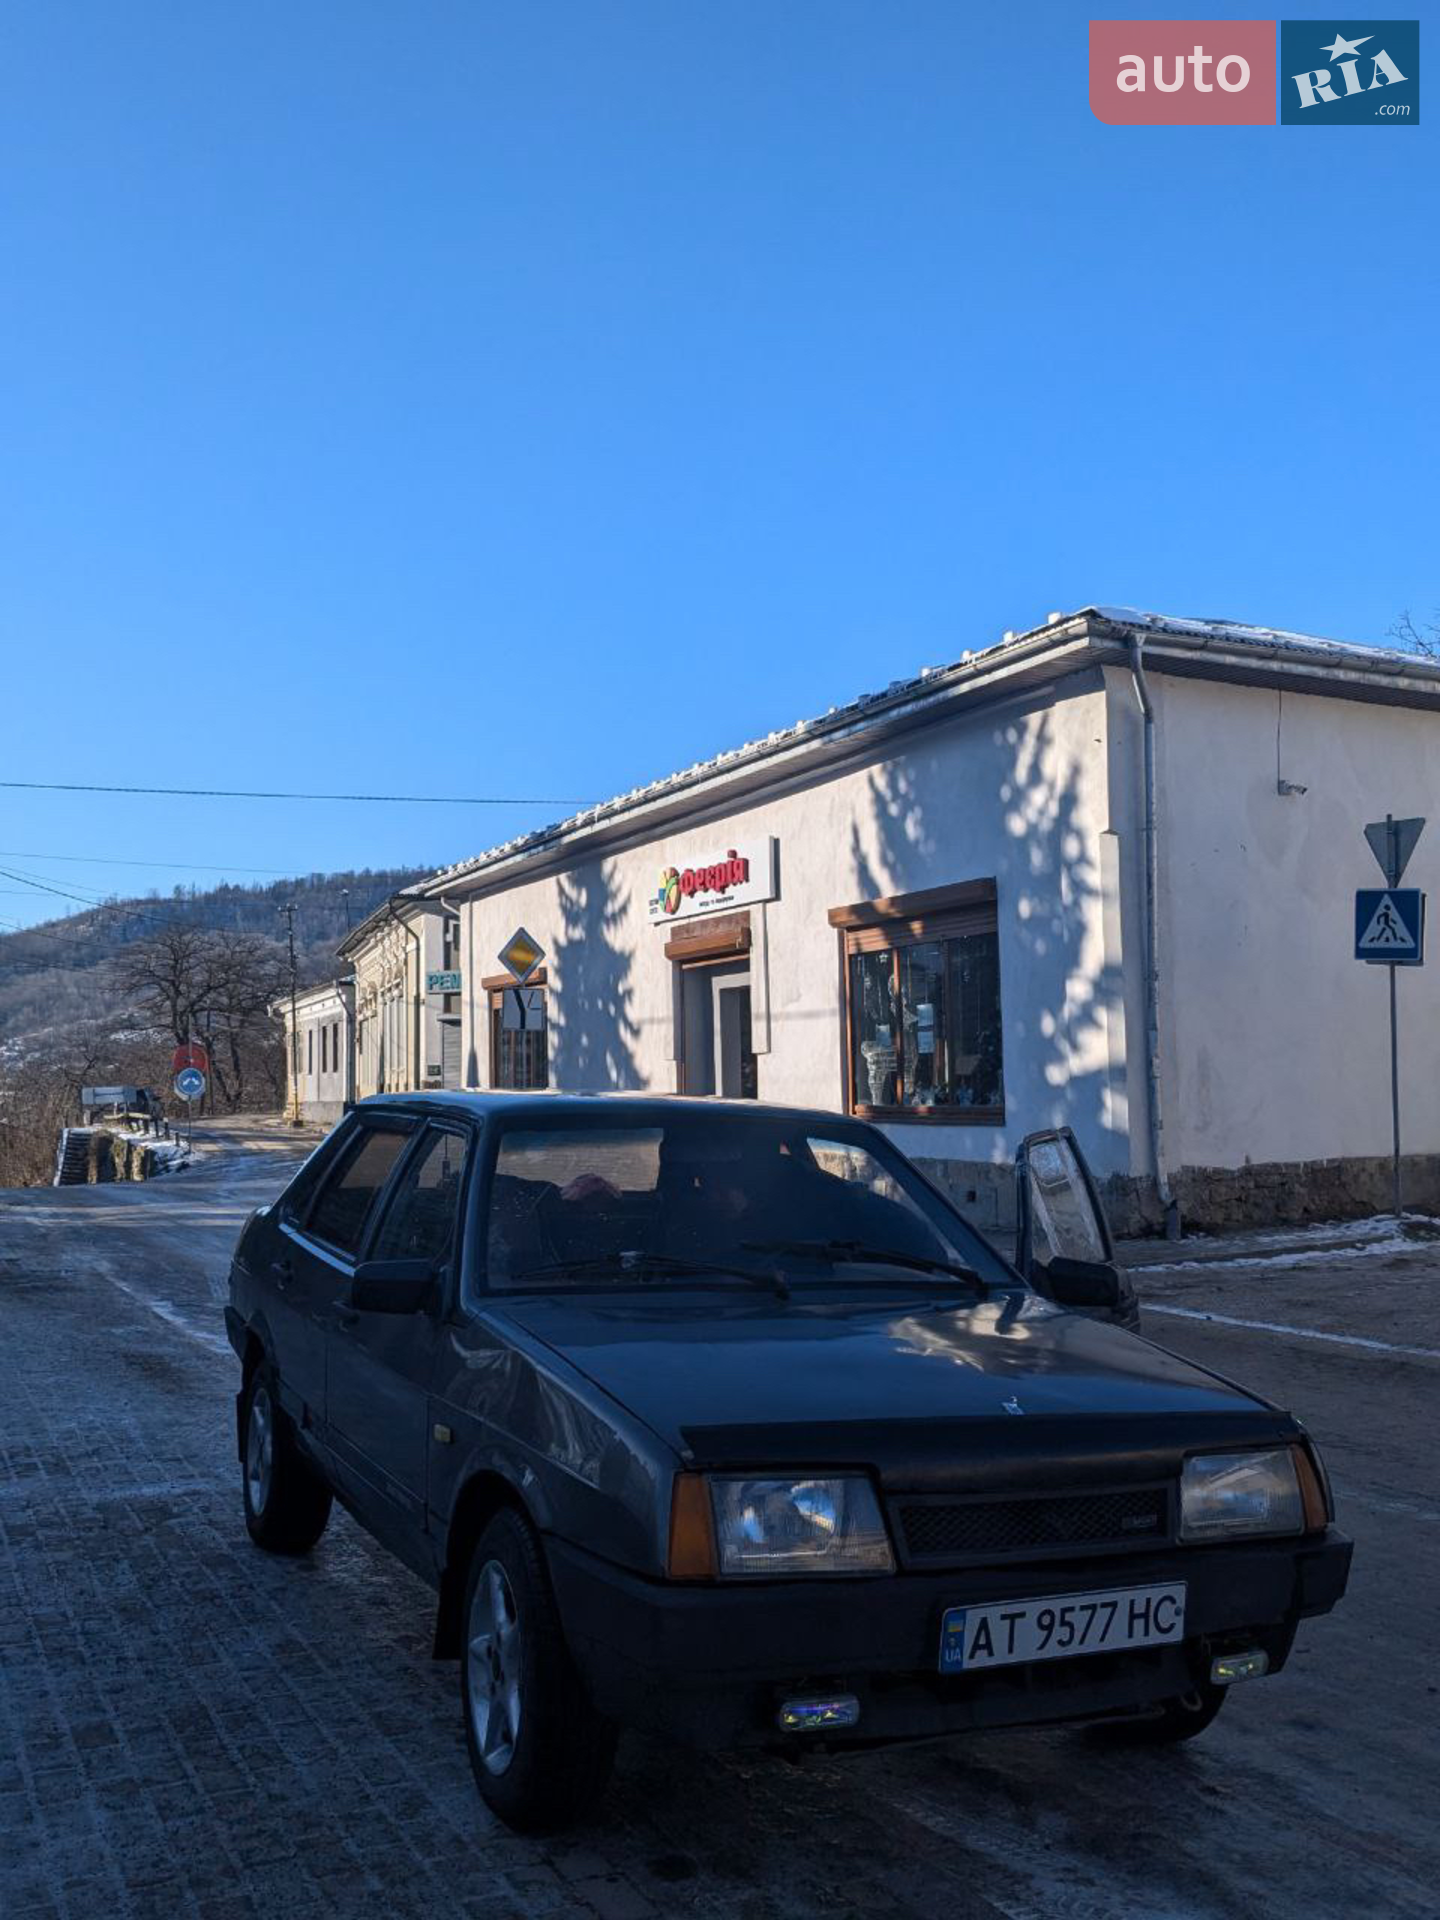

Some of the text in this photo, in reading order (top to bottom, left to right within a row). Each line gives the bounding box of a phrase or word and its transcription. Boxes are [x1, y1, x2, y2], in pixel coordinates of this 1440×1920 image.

[968, 1595, 1177, 1660] AT 9577 HC
[945, 1647, 962, 1663] UA
